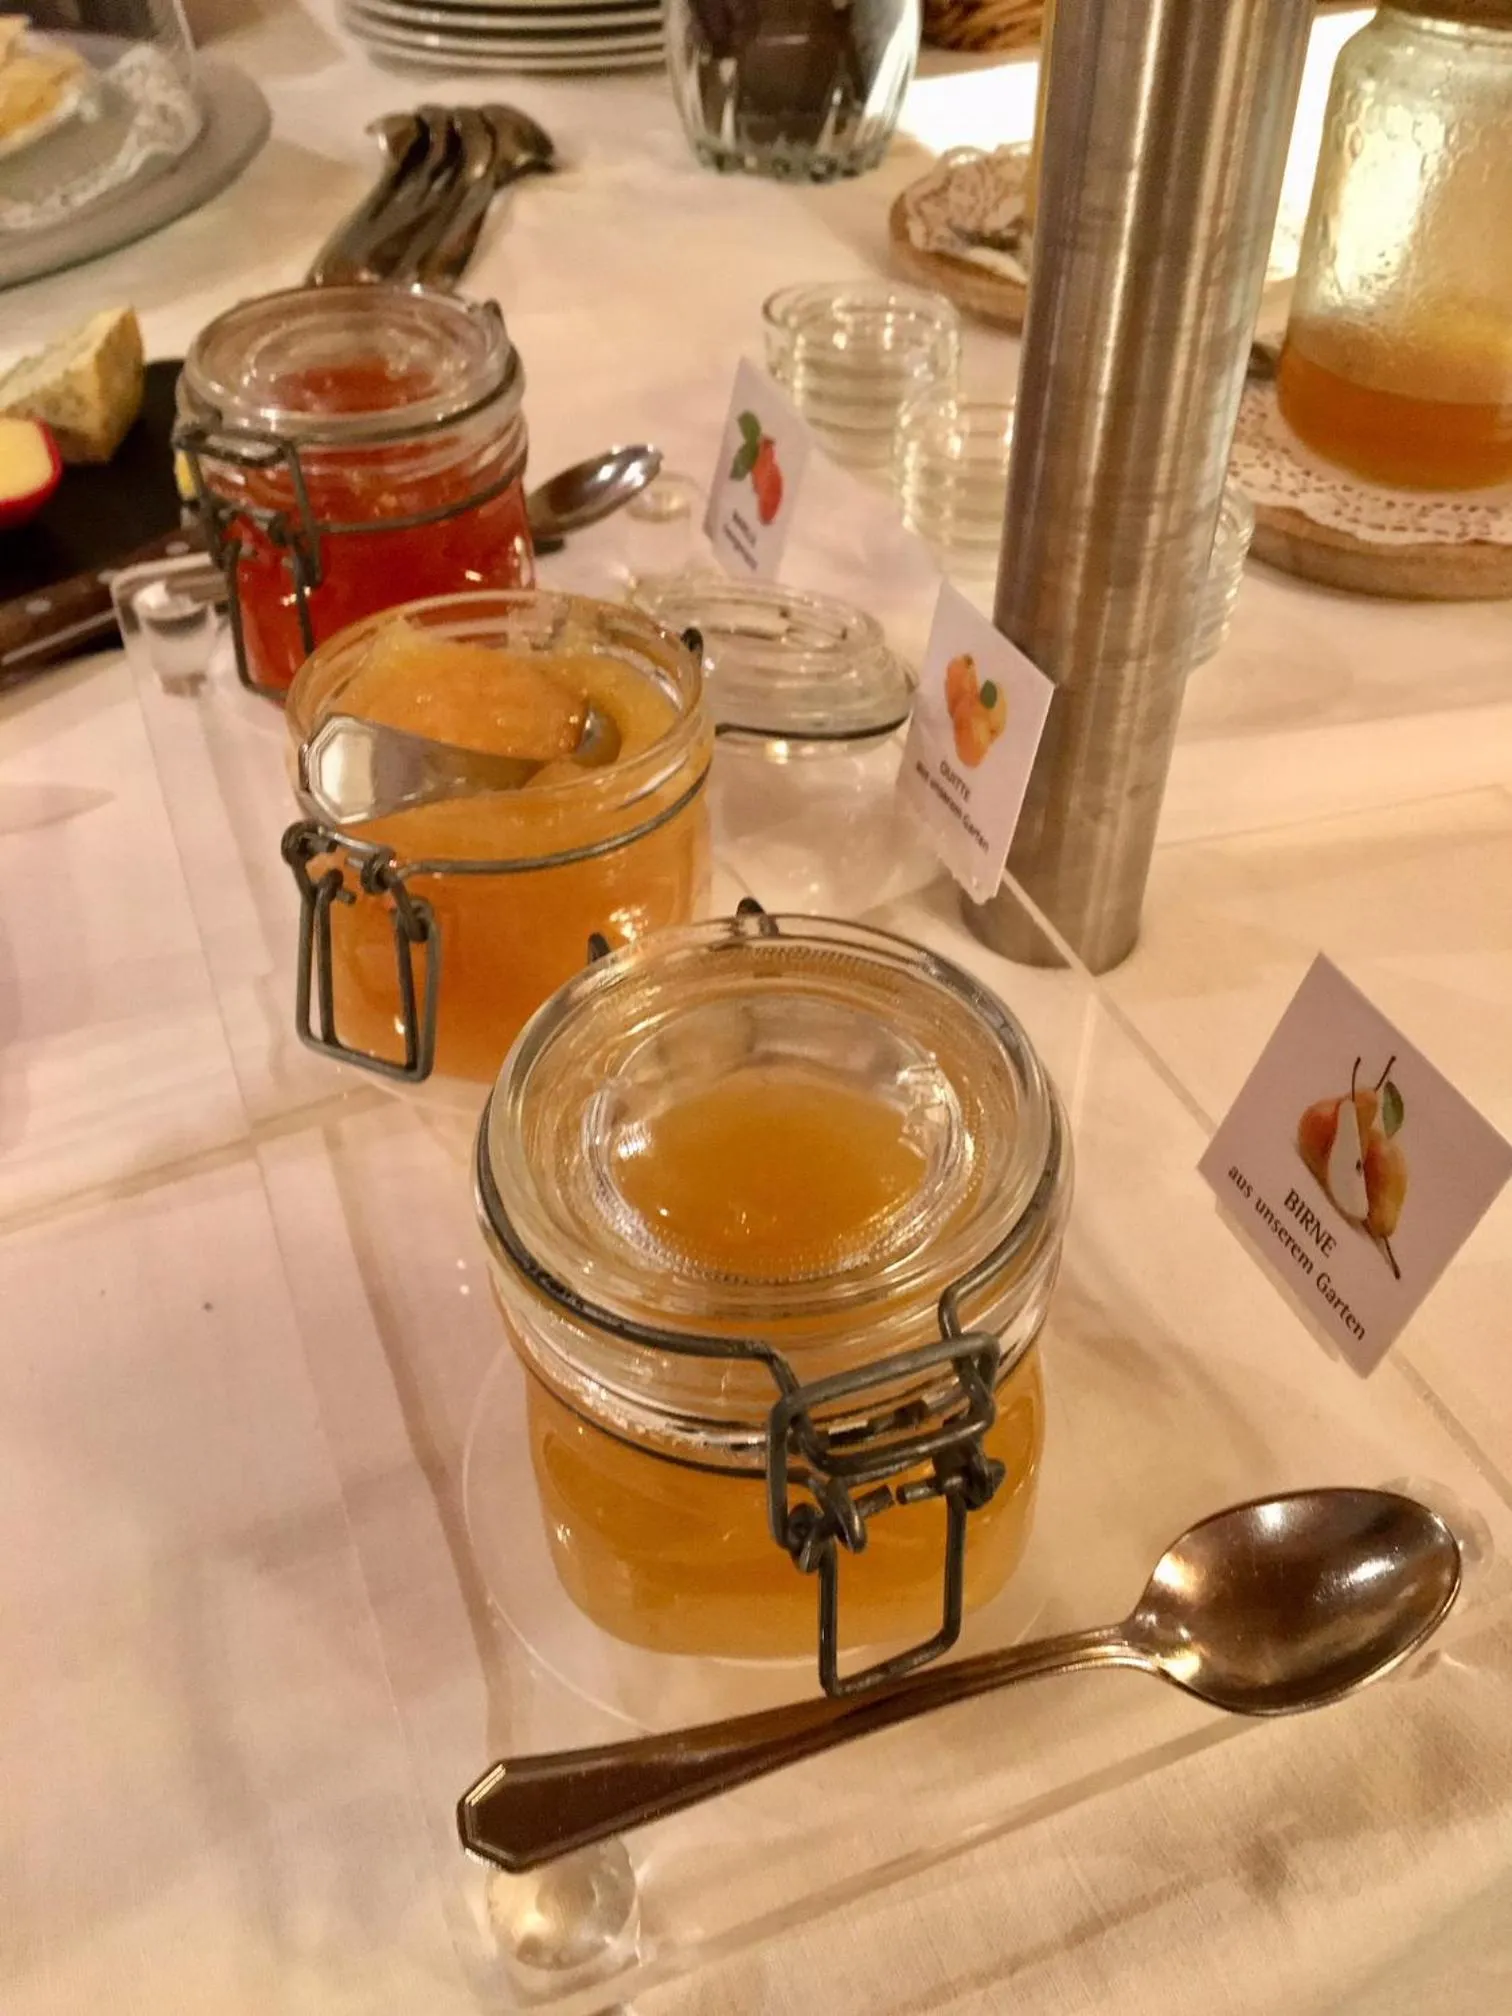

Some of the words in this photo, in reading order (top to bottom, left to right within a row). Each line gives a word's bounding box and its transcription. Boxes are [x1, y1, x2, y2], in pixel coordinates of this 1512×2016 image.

[1228, 1166, 1253, 1198] aus
[1255, 1197, 1314, 1275] unserem
[1316, 1272, 1366, 1341] Garten
[1284, 1187, 1337, 1258] BIRNE
